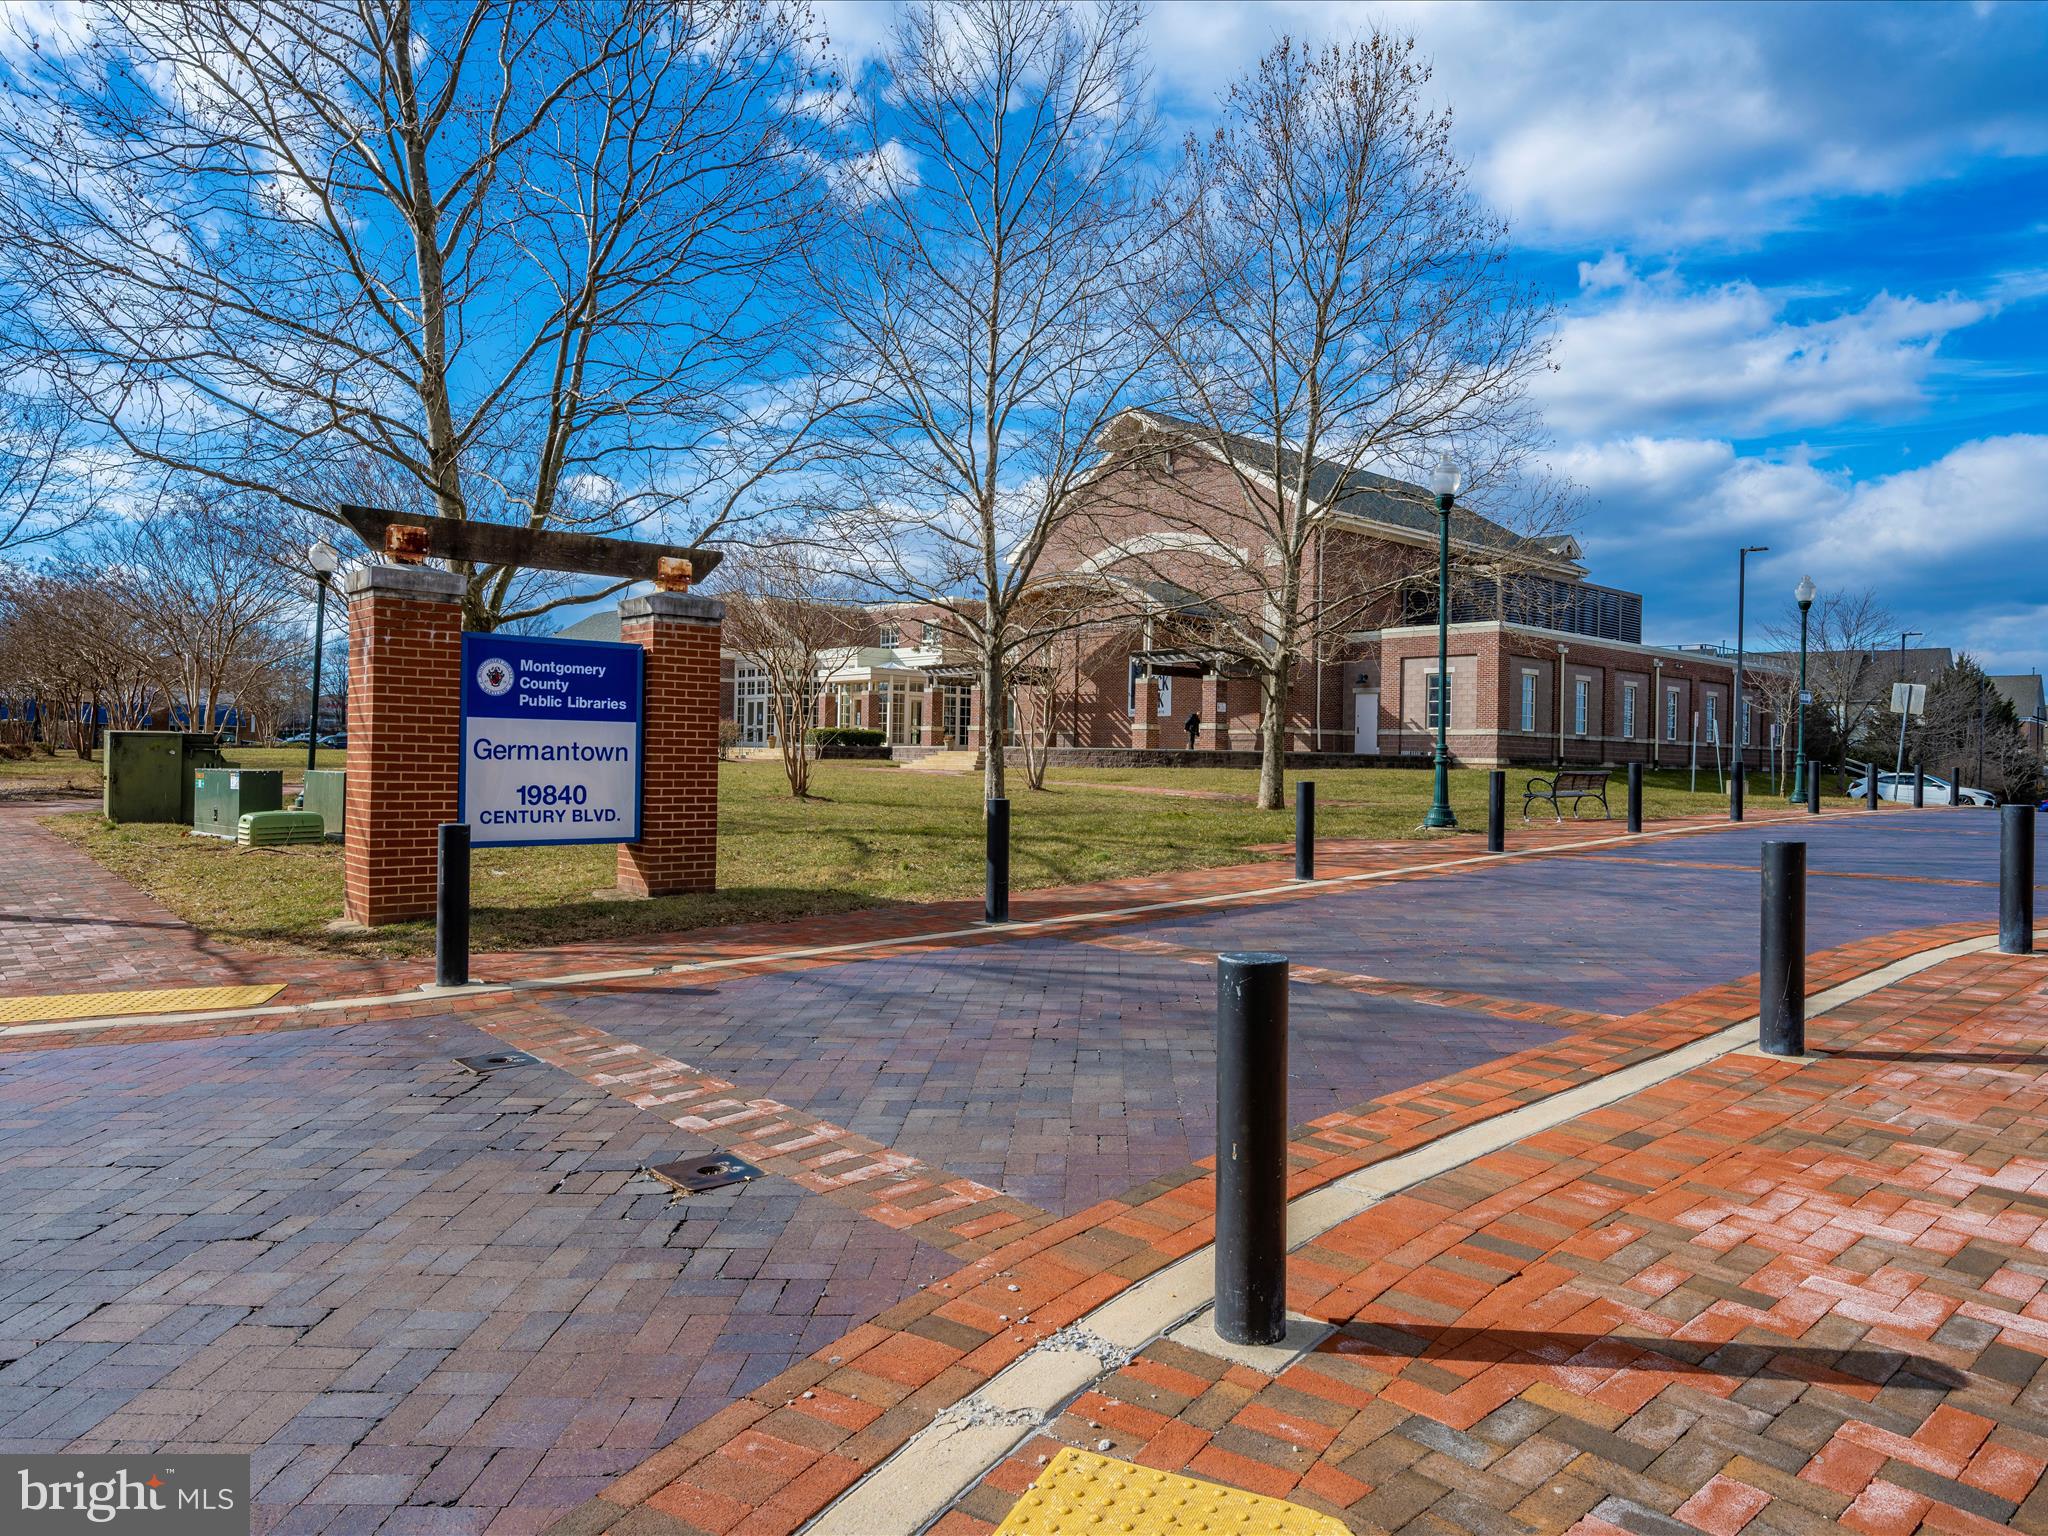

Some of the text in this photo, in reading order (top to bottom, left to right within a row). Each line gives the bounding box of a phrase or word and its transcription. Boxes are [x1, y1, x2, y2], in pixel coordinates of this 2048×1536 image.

[520, 659, 606, 677] Montgomery
[519, 677, 569, 693] County
[519, 694, 627, 710] Public Libraries
[473, 738, 628, 762] Germantown
[516, 784, 587, 806] 19840
[479, 808, 621, 824] CENTURY BLVD.
